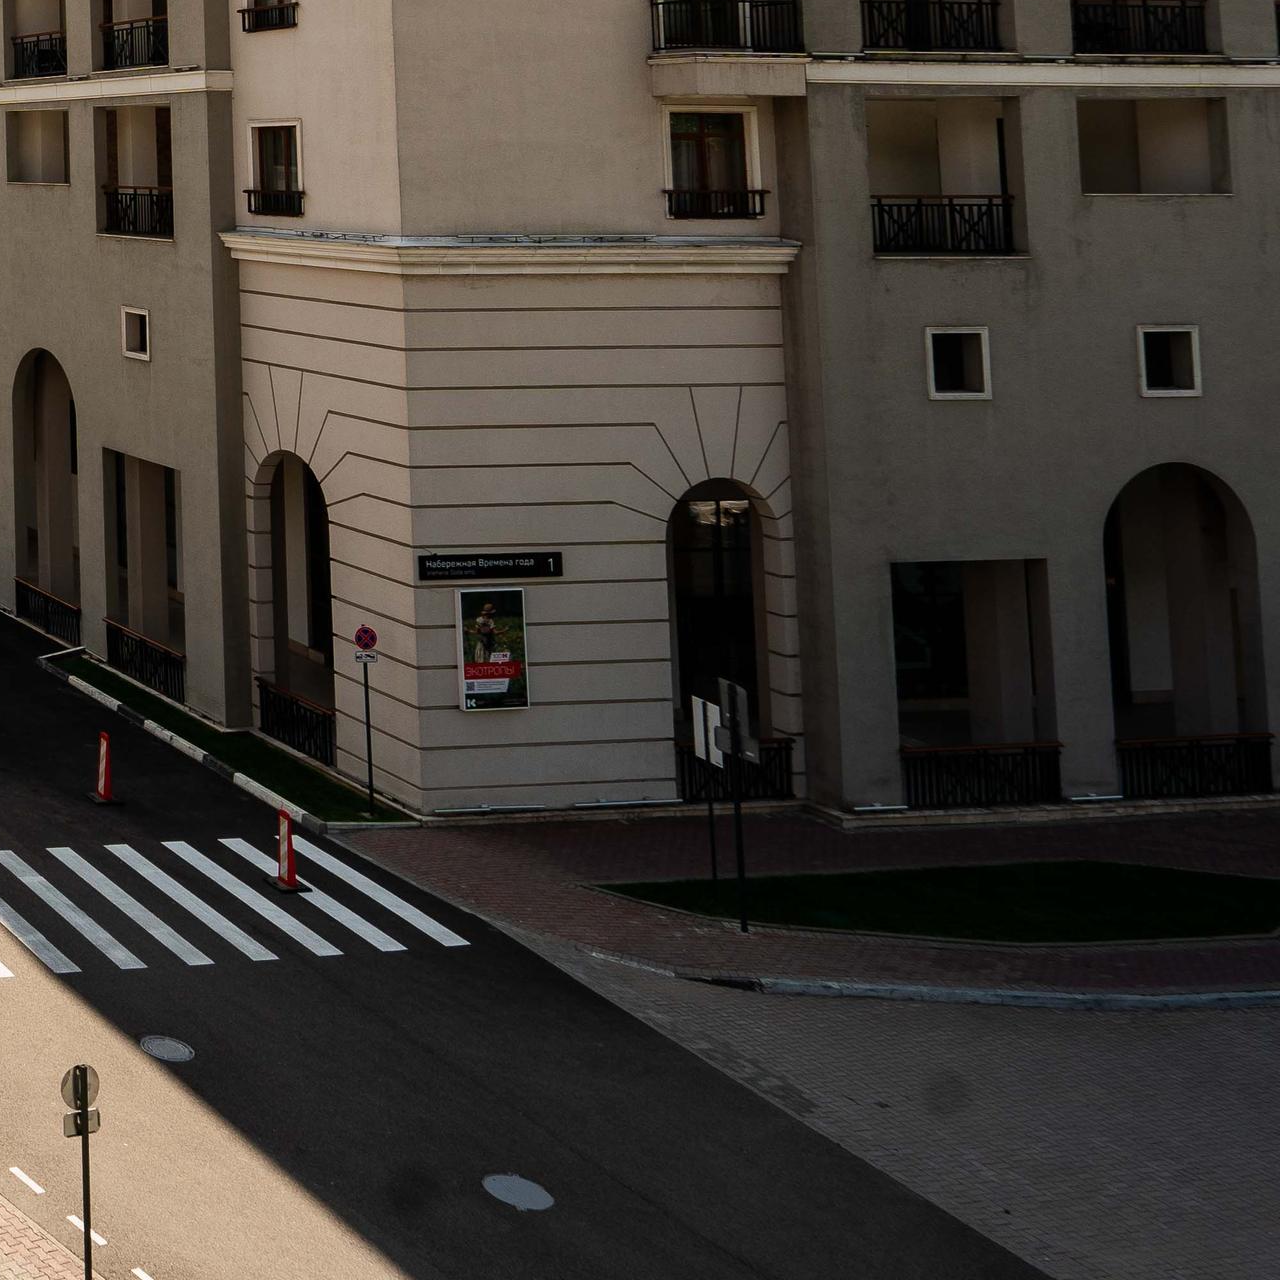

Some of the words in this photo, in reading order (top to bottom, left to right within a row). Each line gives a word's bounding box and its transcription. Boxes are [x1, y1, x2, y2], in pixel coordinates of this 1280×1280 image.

[426, 559, 476, 569] Набережная
[478, 558, 513, 567] Времена
[515, 558, 535, 566] года
[547, 558, 554, 572] 1
